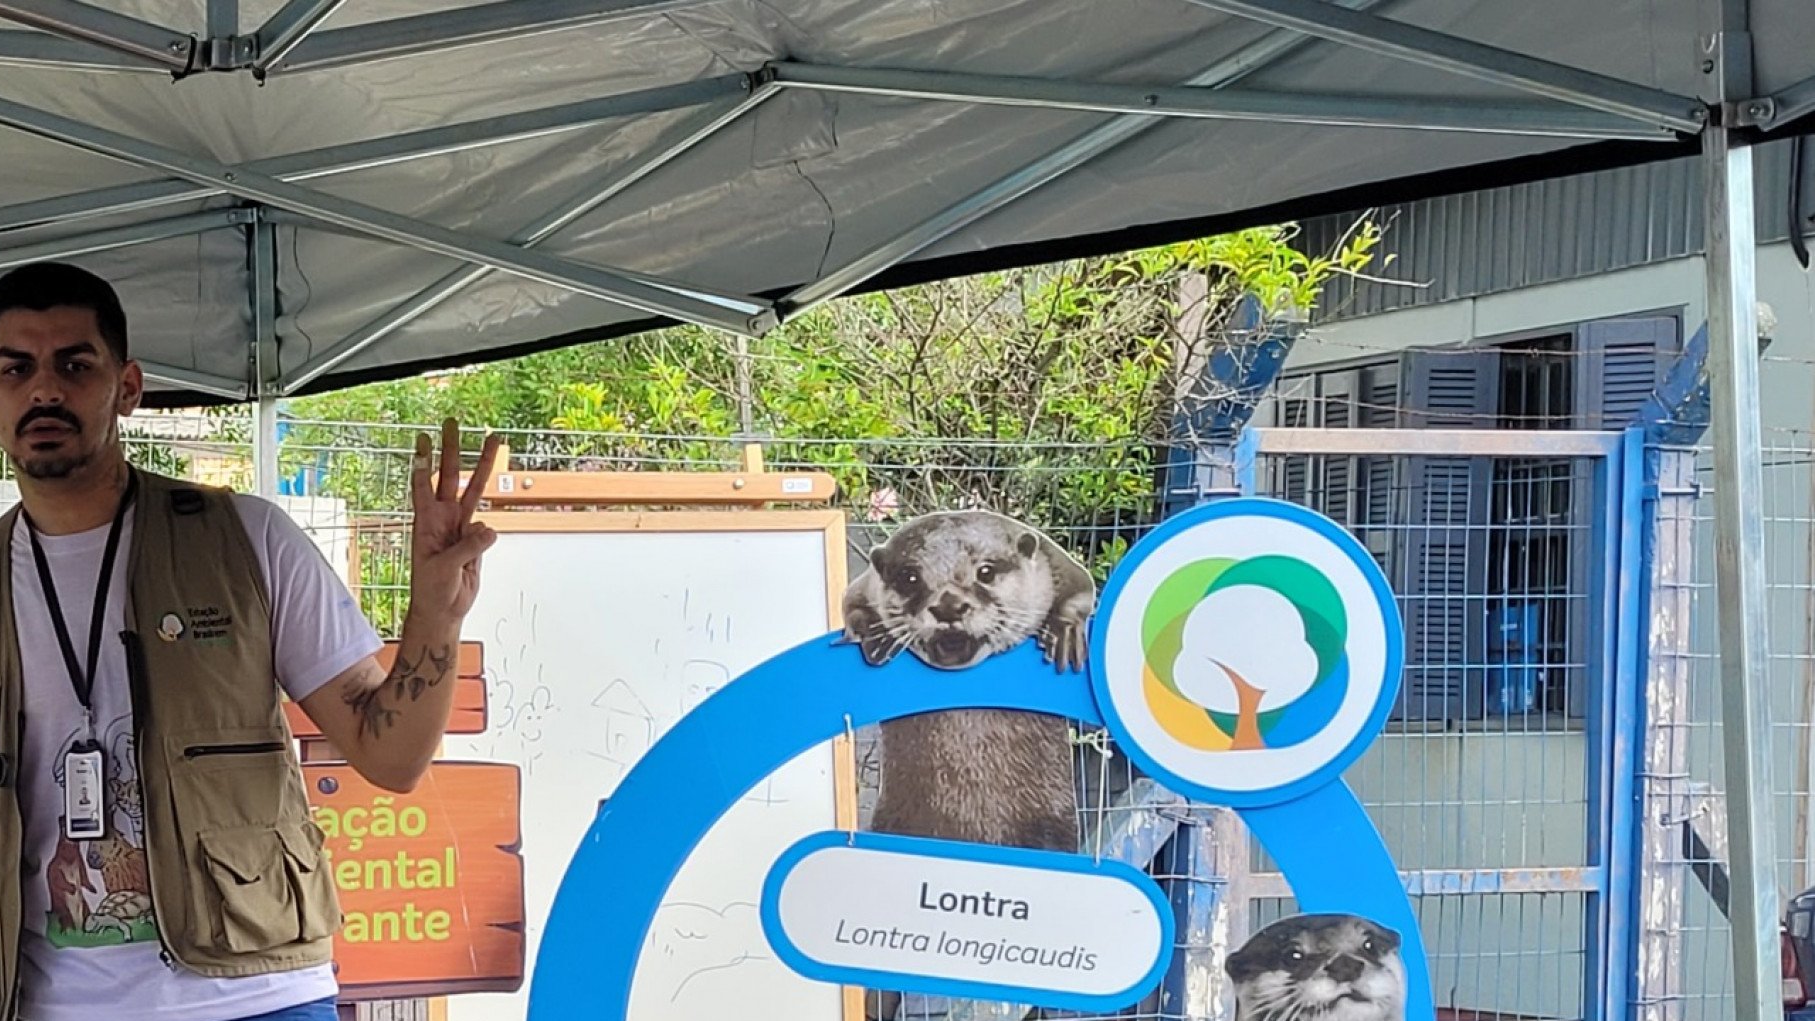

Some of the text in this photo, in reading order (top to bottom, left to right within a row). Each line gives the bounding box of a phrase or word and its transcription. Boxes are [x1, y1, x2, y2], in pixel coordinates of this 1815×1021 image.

[322, 846, 455, 890] ental
[919, 881, 1030, 920] Lontra
[343, 902, 451, 943] ante
[835, 918, 1099, 971] Lontra longicaudis
